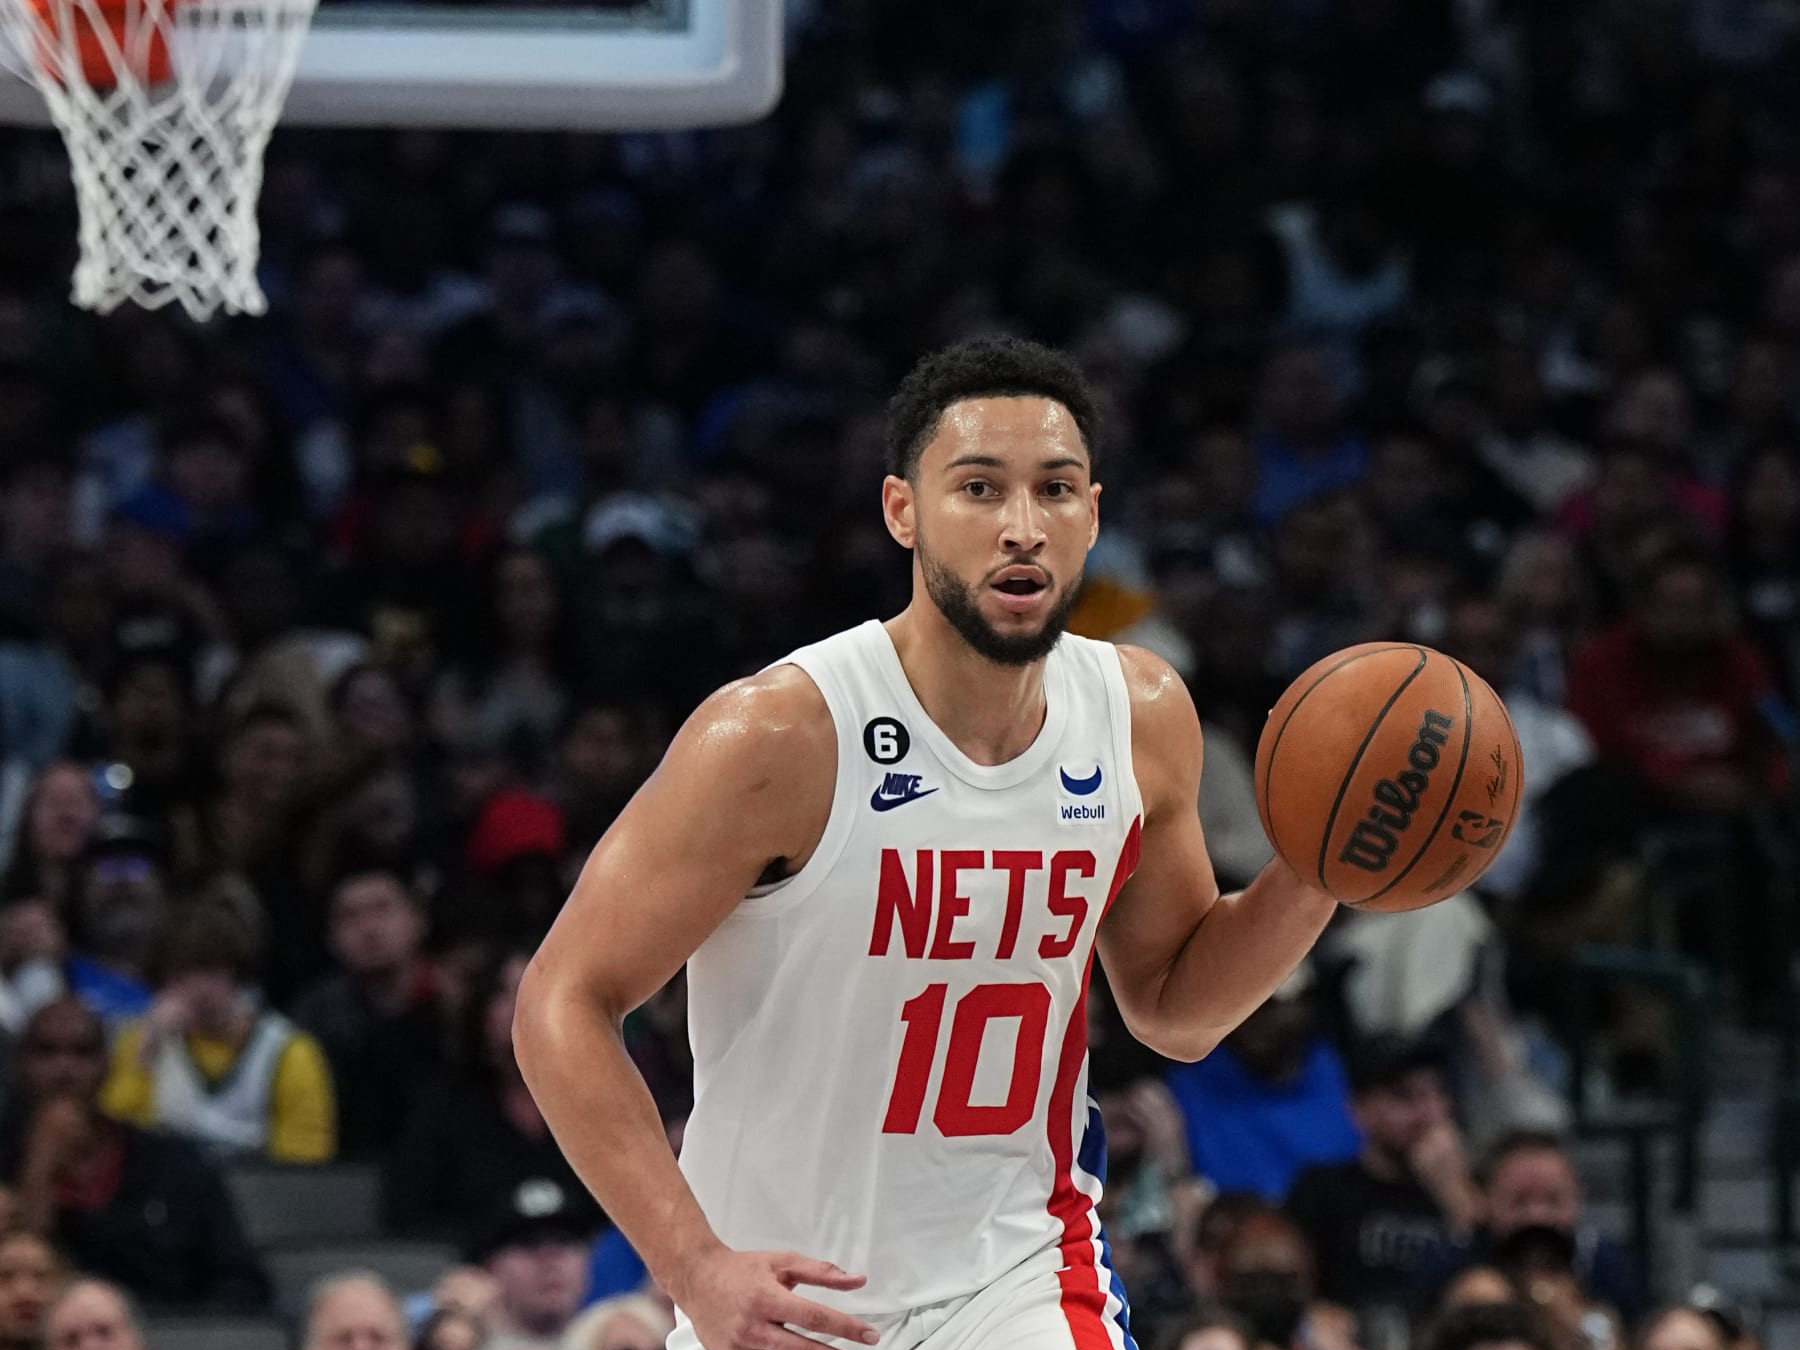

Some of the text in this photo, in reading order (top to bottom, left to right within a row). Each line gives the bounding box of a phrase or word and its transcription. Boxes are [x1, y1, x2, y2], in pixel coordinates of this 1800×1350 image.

[874, 724, 898, 759] 6
[881, 772, 923, 798] NIKE
[1061, 804, 1104, 819] Webull
[1338, 709, 1454, 872] Wilson
[868, 848, 1096, 960] NETS
[882, 982, 1052, 1137] 10
